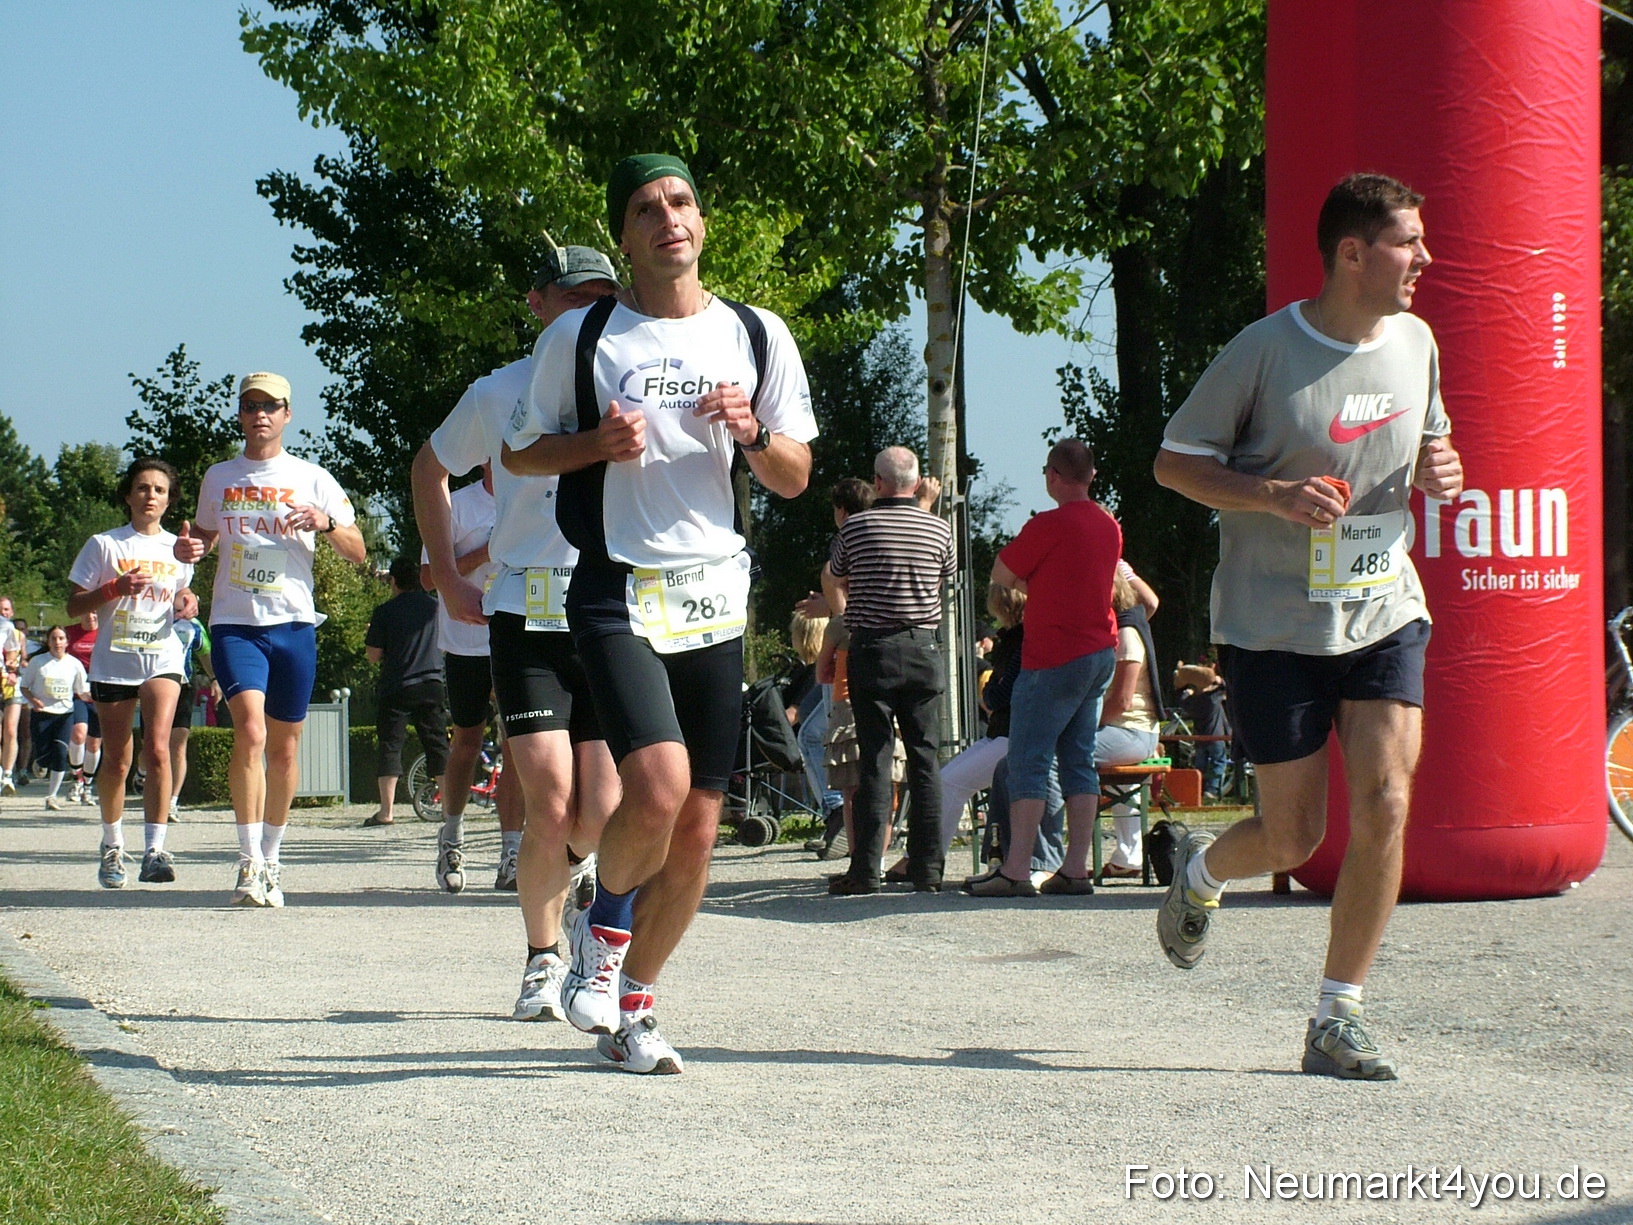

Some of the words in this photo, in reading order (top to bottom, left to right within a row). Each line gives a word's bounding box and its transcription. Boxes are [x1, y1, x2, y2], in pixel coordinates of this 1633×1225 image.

[1552, 292, 1567, 331] 1929
[1553, 338, 1567, 369] Seit
[643, 375, 740, 397] Fisch
[659, 399, 697, 410] Auto
[1340, 392, 1394, 422] NIKE
[223, 485, 296, 504] MERZ
[222, 516, 294, 536] TEAM
[1341, 524, 1382, 540] Martin
[243, 549, 259, 561] Ralf
[1315, 549, 1322, 562] D
[1349, 550, 1390, 577] 488
[246, 568, 276, 584] 405
[666, 563, 705, 588] Bernd
[1461, 566, 1516, 591] Sicher
[1520, 568, 1539, 590] ist
[1543, 565, 1581, 590] sicher
[531, 584, 537, 595] D
[644, 601, 652, 614] C
[682, 593, 731, 624] 282
[133, 631, 158, 642] 406
[510, 709, 554, 721] STAEDTLER
